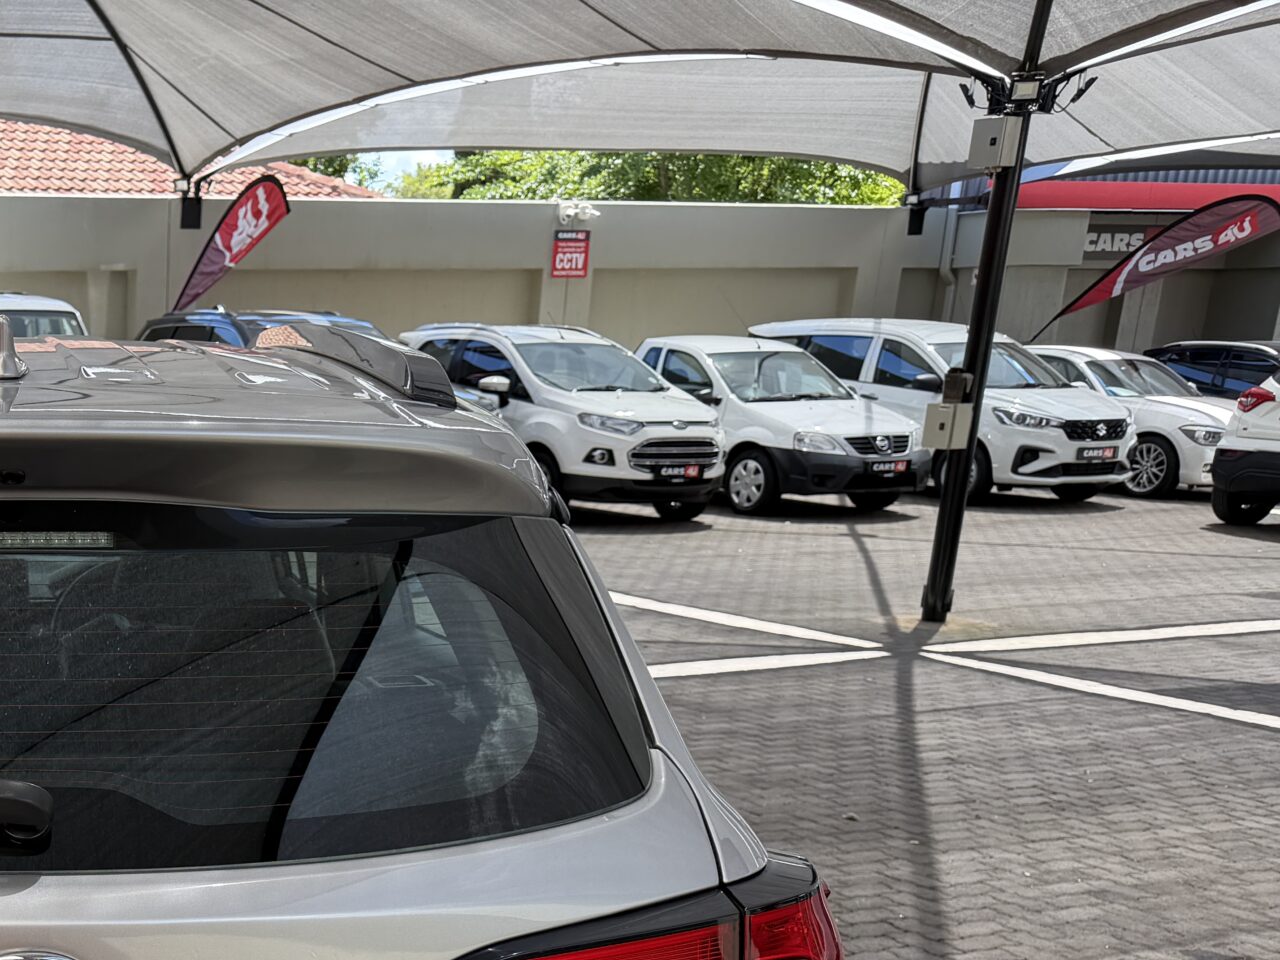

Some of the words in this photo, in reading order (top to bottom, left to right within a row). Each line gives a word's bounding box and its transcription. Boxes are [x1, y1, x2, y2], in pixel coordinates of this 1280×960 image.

[1083, 233, 1144, 252] CARS
[1138, 235, 1214, 272] CARS
[1218, 216, 1252, 246] 4U
[555, 253, 586, 269] CCTV
[1083, 449, 1103, 457] CARS
